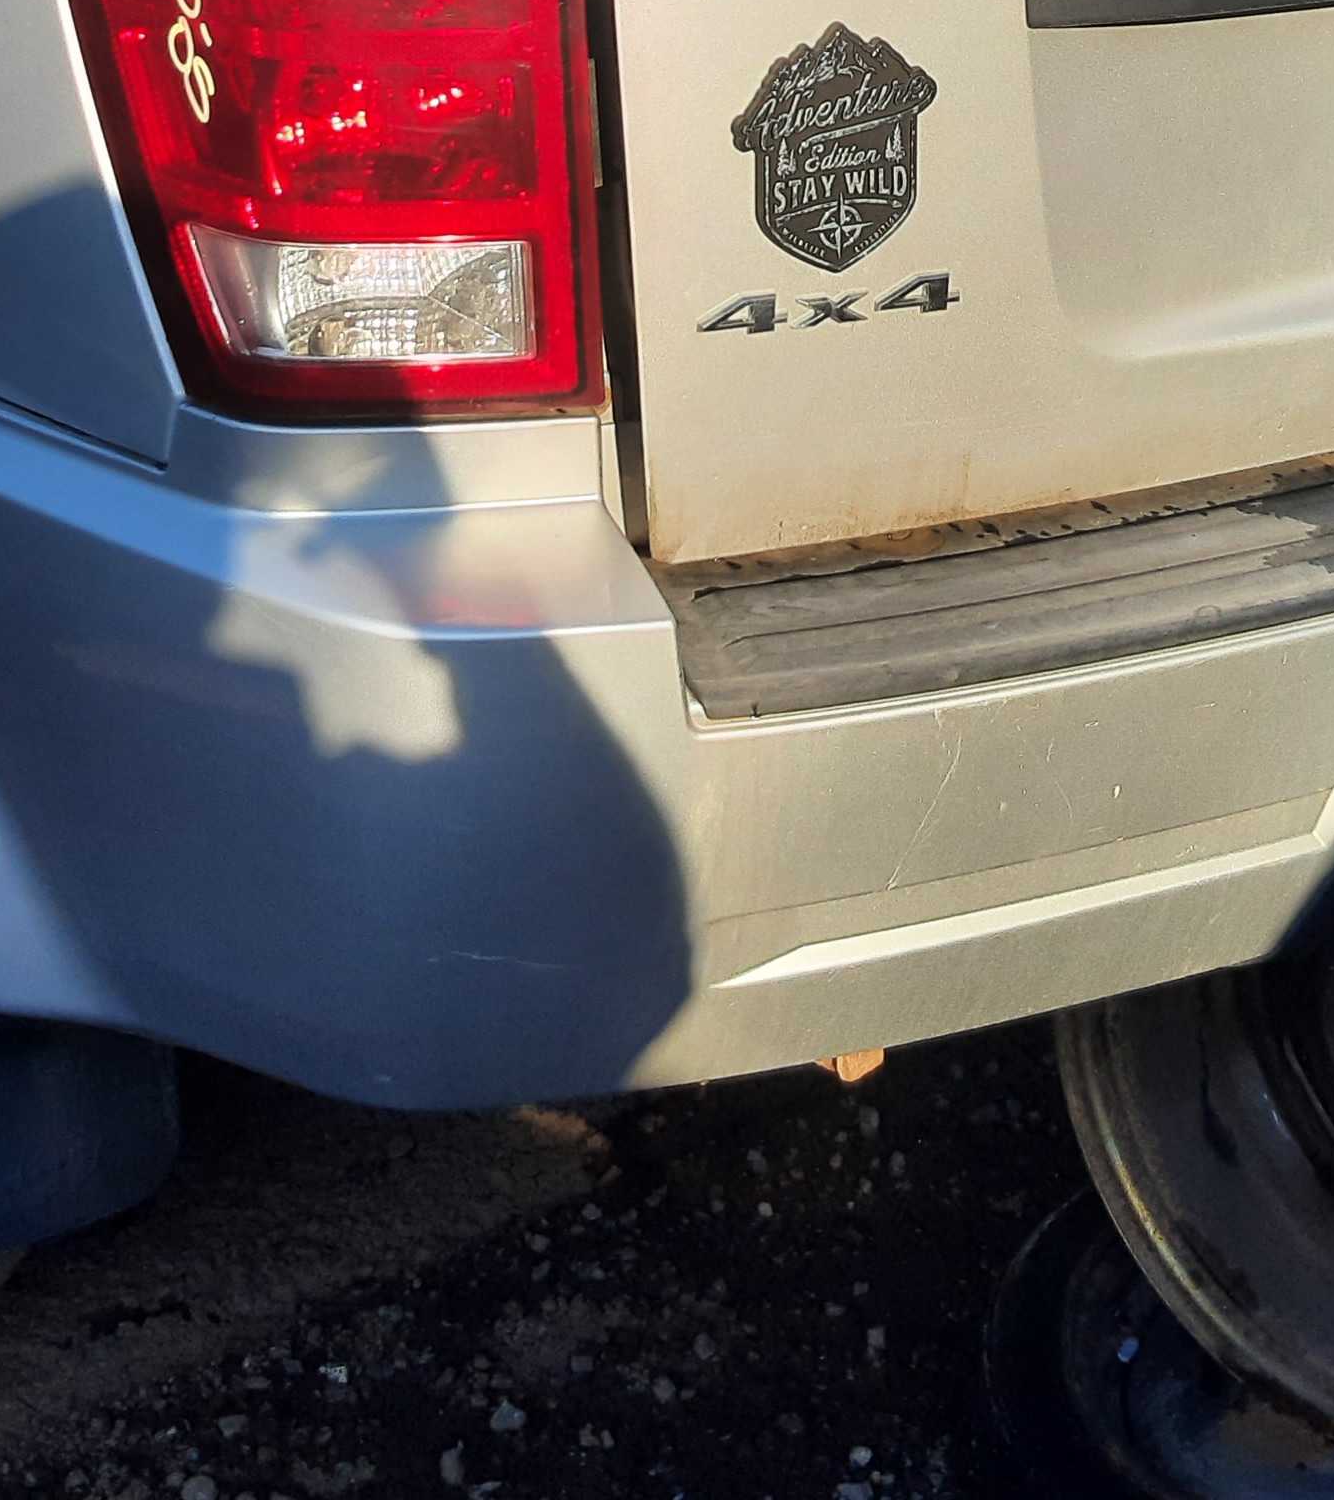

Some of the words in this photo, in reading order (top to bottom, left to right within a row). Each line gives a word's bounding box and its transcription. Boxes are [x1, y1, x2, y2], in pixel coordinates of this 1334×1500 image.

[744, 70, 931, 152] Adventure
[804, 141, 881, 174] Edition
[773, 173, 836, 214] STAY
[844, 165, 908, 198] WILD
